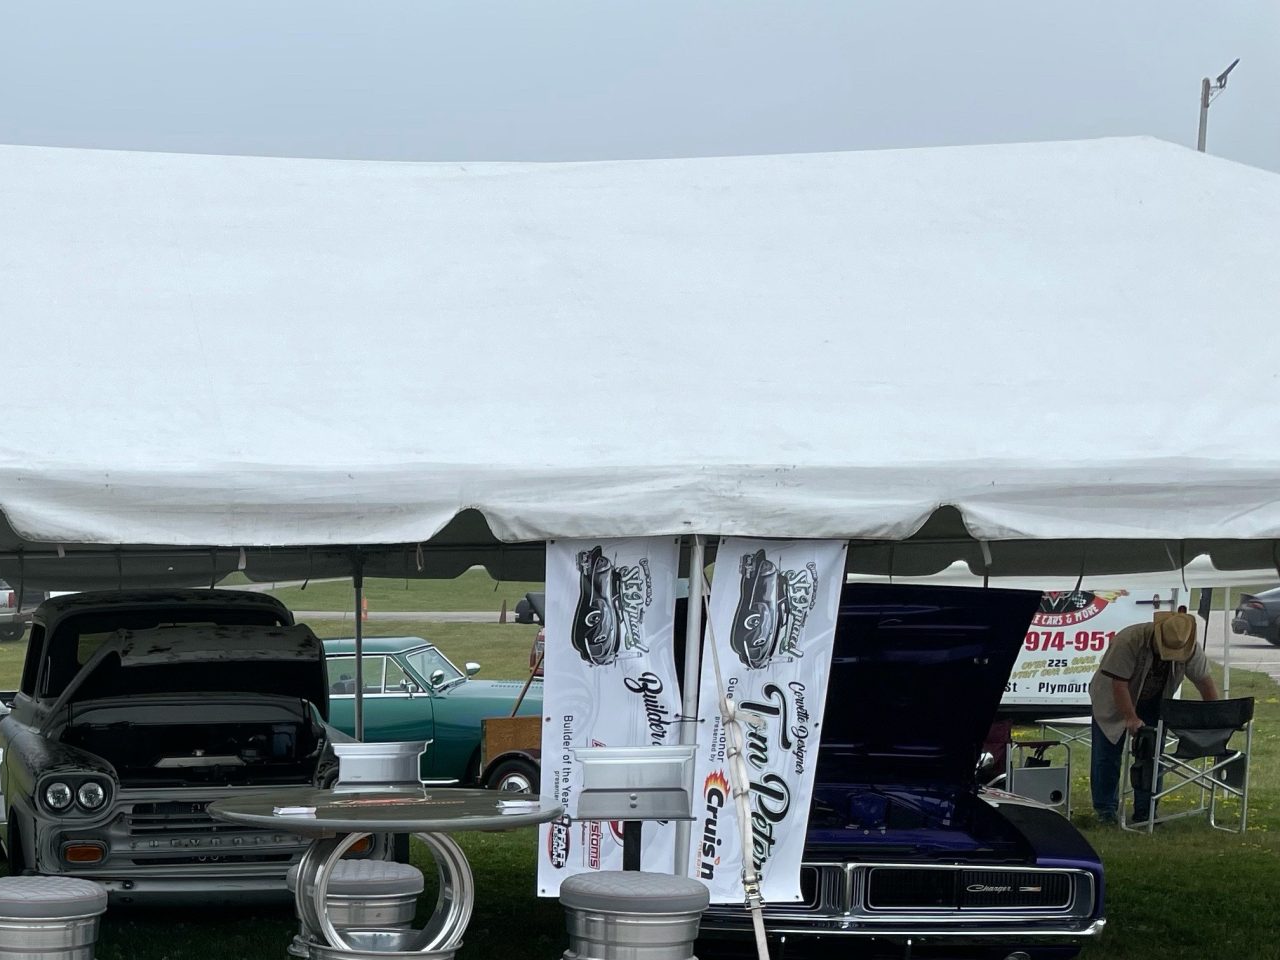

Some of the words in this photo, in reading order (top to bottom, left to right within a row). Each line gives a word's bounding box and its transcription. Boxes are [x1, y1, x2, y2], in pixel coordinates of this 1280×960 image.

[1041, 615, 1063, 626] CARS
[1074, 604, 1100, 621] MORE
[1047, 659, 1068, 668] 225
[725, 677, 738, 699] Gue
[788, 681, 809, 724] Corvette
[624, 671, 671, 741] Builder
[562, 715, 574, 752] Builder
[710, 716, 721, 752] presented
[740, 684, 792, 769] Tom
[562, 755, 573, 764] of
[708, 753, 717, 763] by
[790, 725, 808, 775] Designer
[562, 767, 572, 783] the
[561, 785, 572, 808] Year
[551, 824, 559, 866] DESIGNS
[557, 824, 567, 868] PFAFF
[966, 884, 1014, 894] Charger
